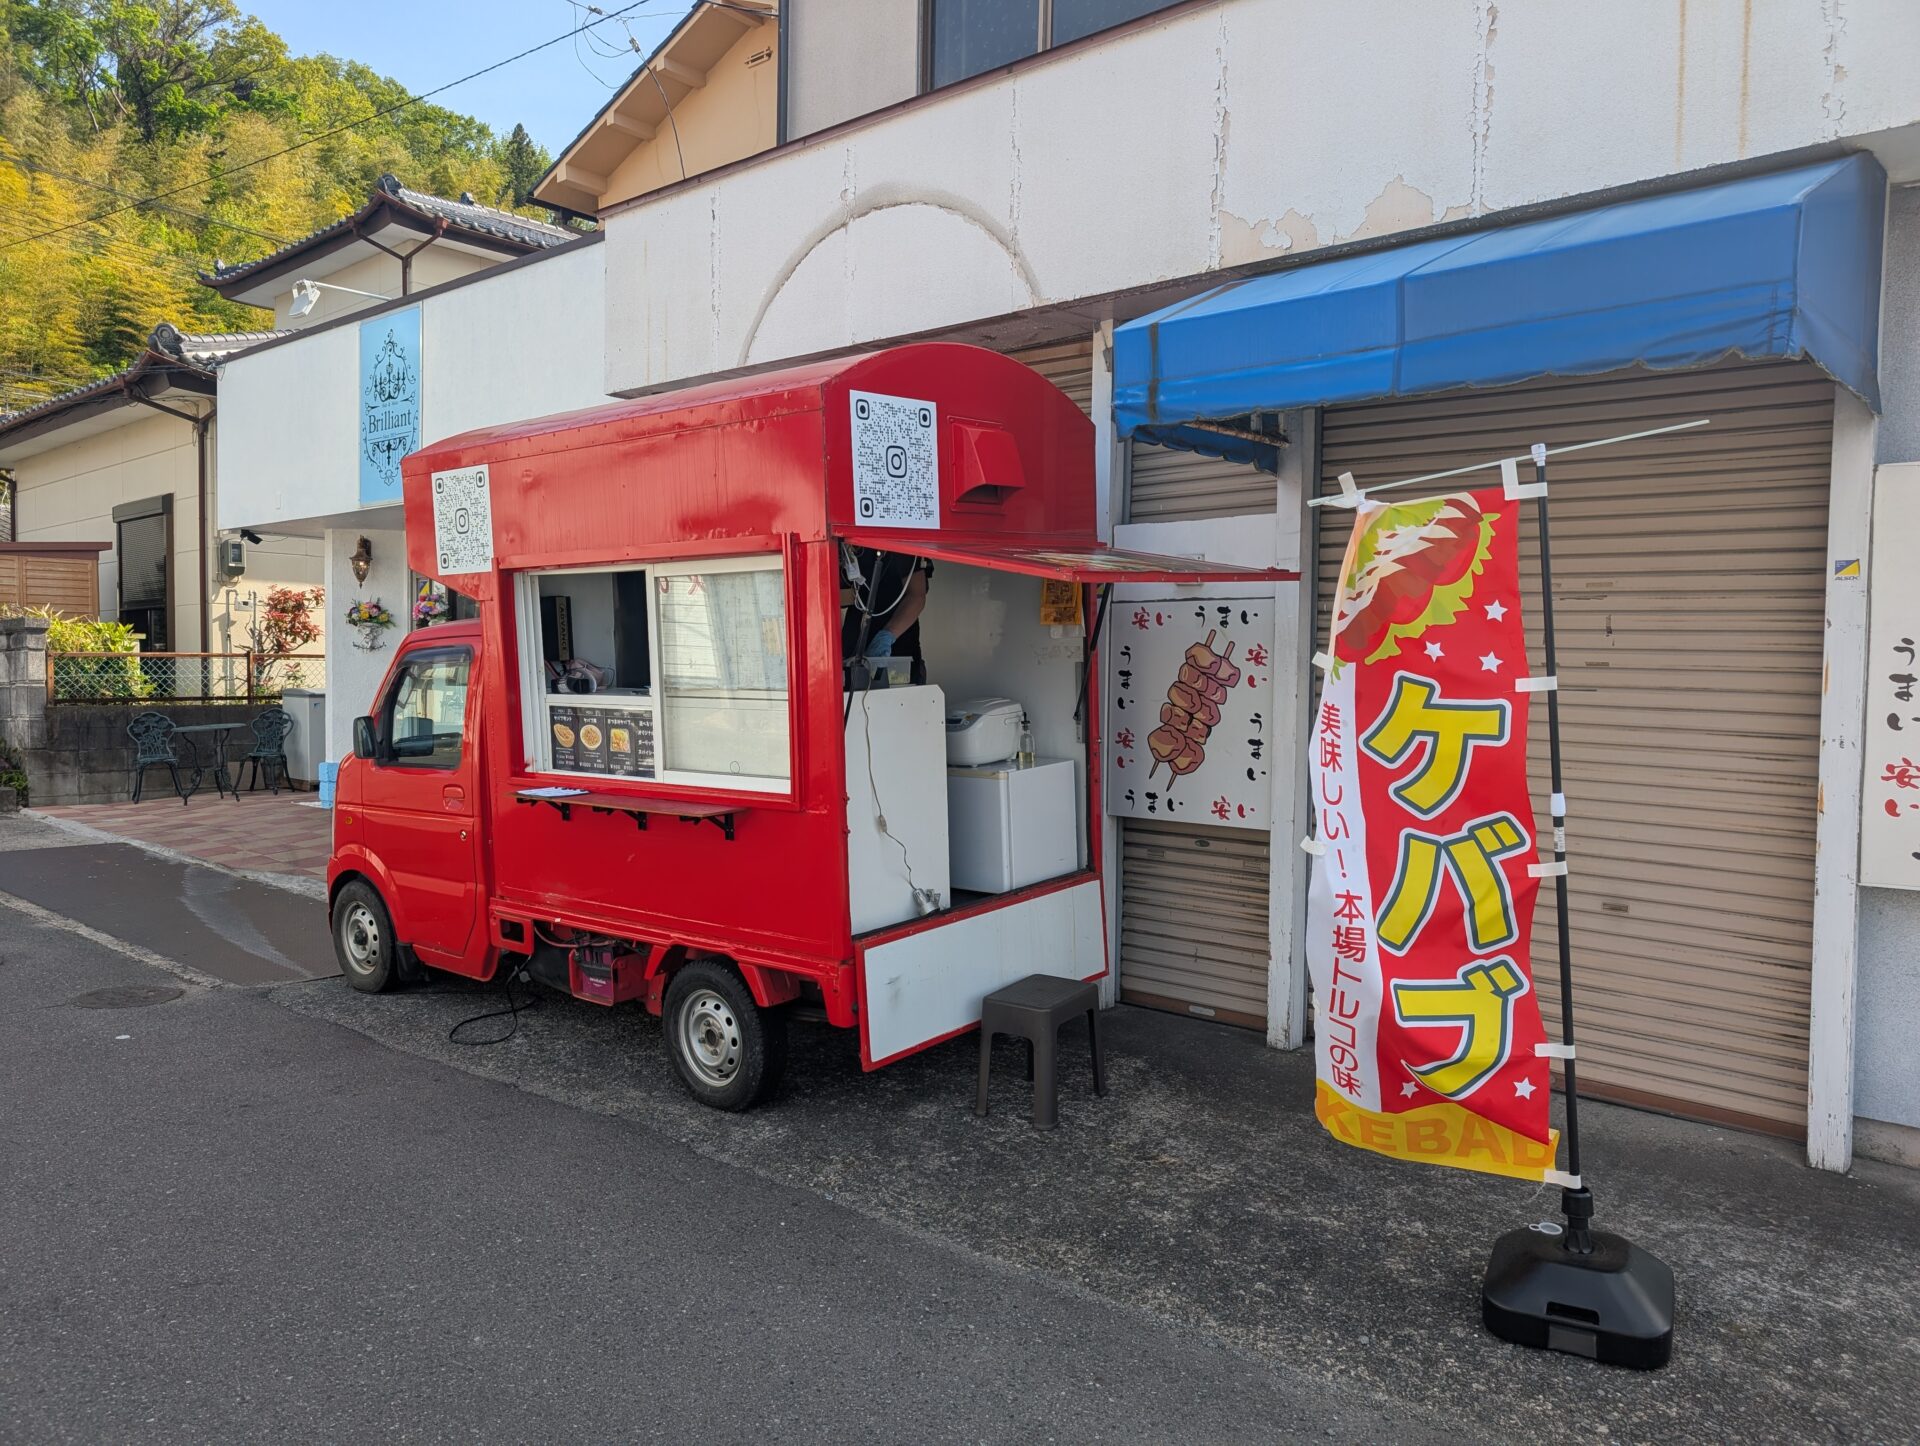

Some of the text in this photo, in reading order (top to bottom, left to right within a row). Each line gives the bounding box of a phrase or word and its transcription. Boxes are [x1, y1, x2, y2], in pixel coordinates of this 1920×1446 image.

[368, 409, 412, 434] Brilliant
[1131, 605, 1259, 630] 安い うまい
[1117, 645, 1135, 710] うまい
[1244, 643, 1268, 688] 安い
[1115, 727, 1135, 769] 安い
[1246, 712, 1267, 781] うまい
[1124, 789, 1184, 813] うまい
[1211, 795, 1256, 821] 安い
[1360, 671, 1530, 1099] ケバブ
